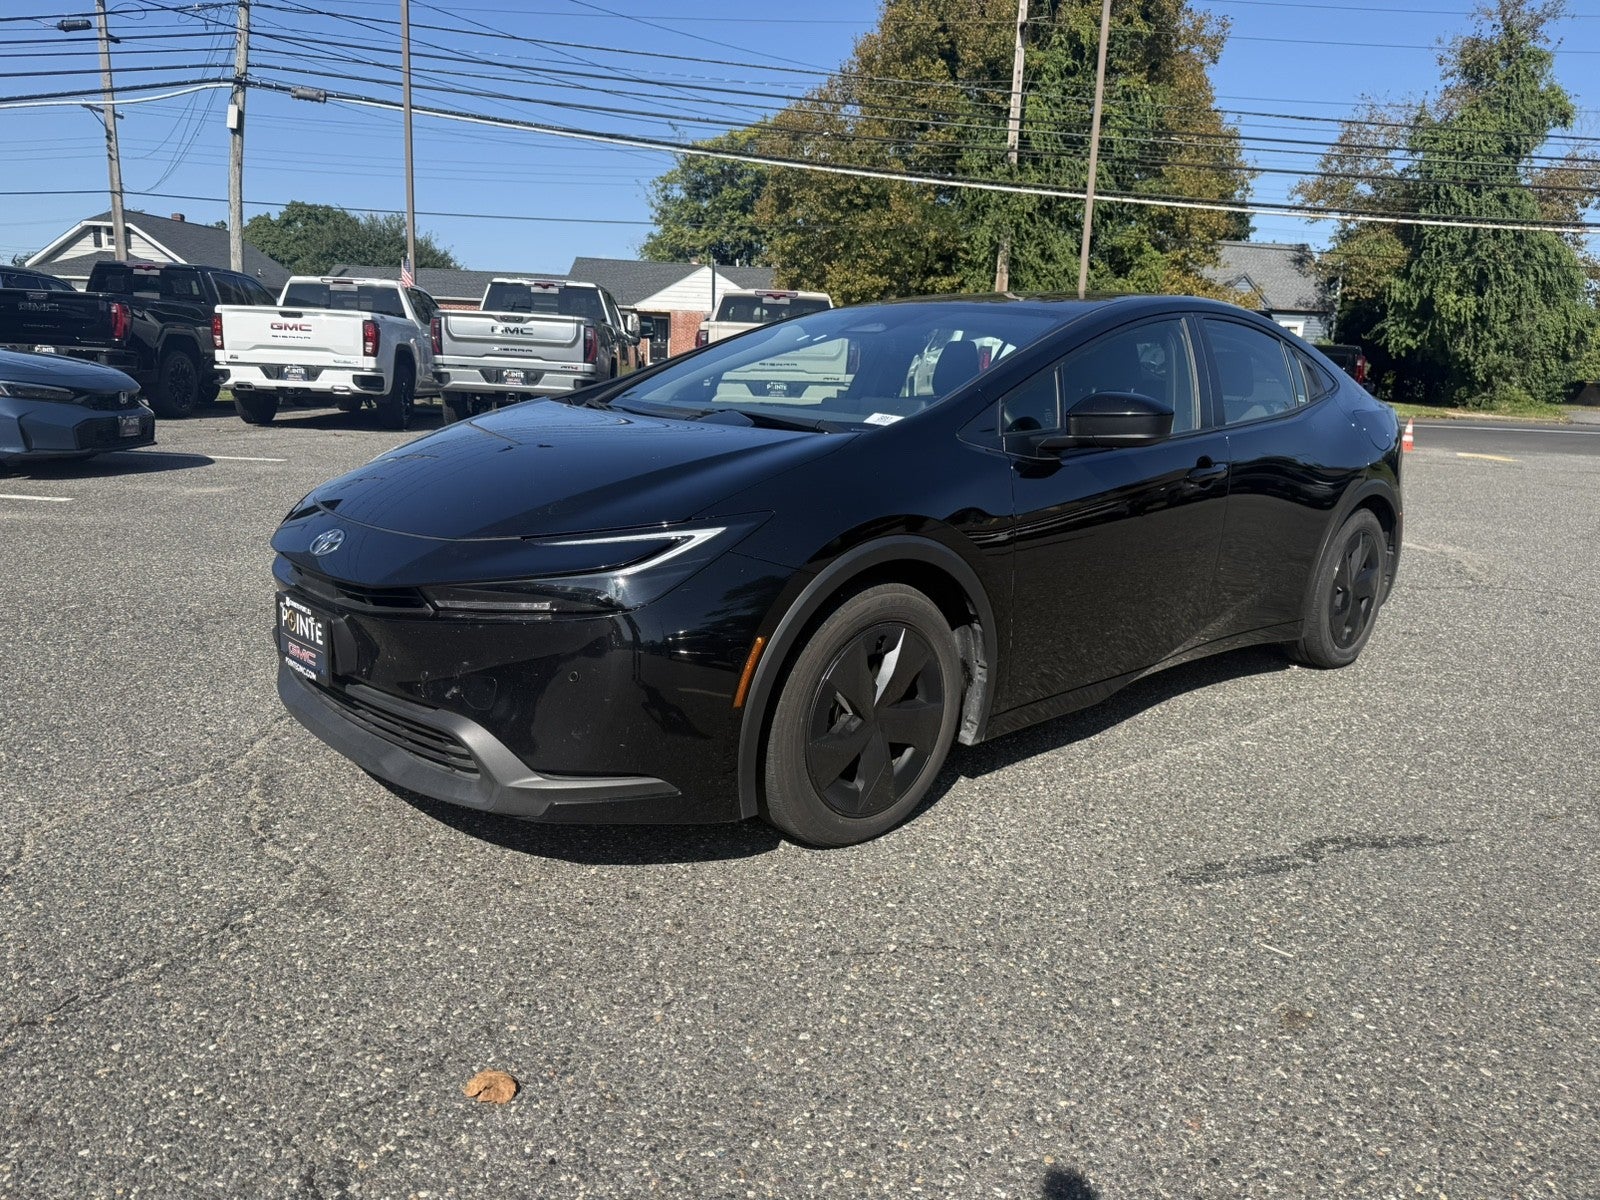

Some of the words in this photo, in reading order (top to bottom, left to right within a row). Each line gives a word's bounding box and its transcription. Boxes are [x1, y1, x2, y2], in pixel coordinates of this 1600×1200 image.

[271, 323, 312, 332] GMC
[281, 606, 324, 646] POINTE
[288, 641, 316, 667] GMC
